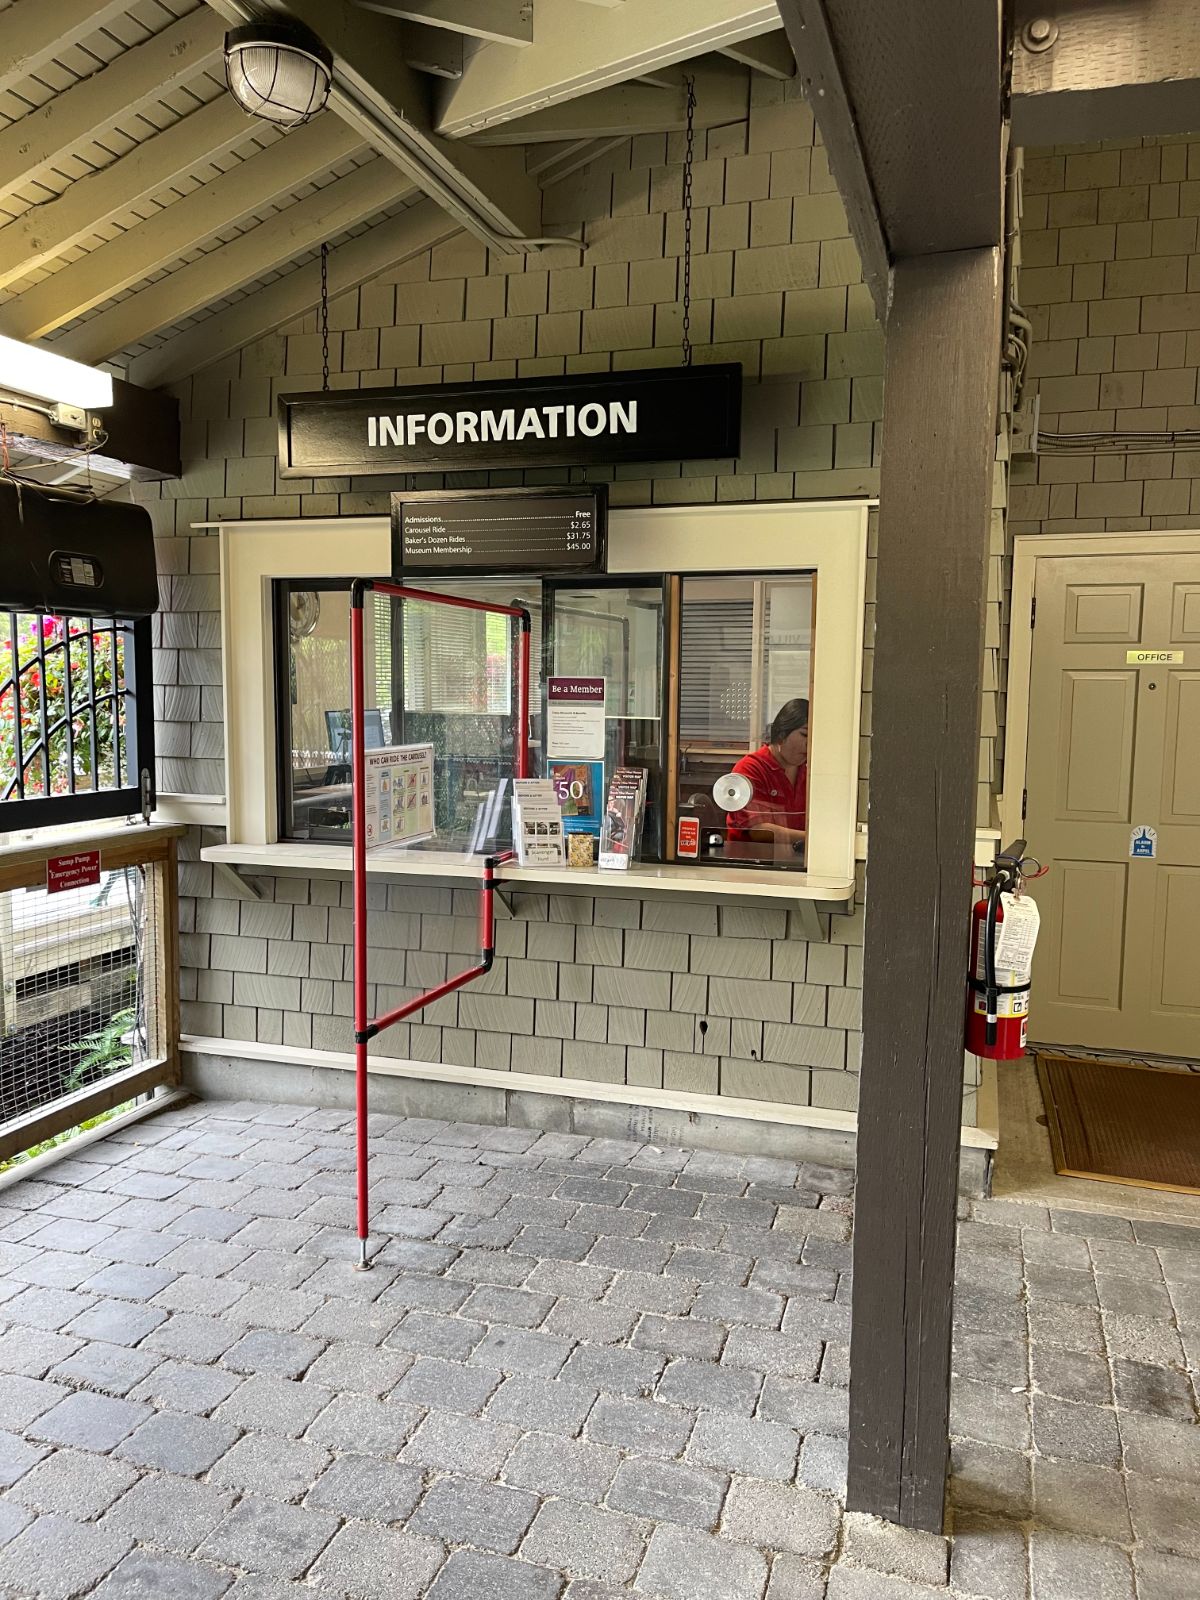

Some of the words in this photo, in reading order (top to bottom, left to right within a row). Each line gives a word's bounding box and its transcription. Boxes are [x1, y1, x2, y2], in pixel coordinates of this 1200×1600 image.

[367, 400, 637, 447] INFORMATION
[404, 515, 441, 523] Admissions
[575, 510, 591, 518] Free
[404, 526, 431, 534] Carousel
[570, 521, 591, 529] $2.65
[566, 532, 591, 540] $31.75
[433, 546, 472, 554] Membership
[566, 542, 591, 551] $45.00
[1137, 653, 1173, 661] OFFICE
[552, 685, 562, 693] Be
[570, 685, 603, 694] Member
[369, 757, 380, 766] WHO
[380, 756, 389, 764] CAN
[389, 755, 400, 763] RIDE
[558, 780, 584, 800] 50
[60, 878, 89, 888] Connection
